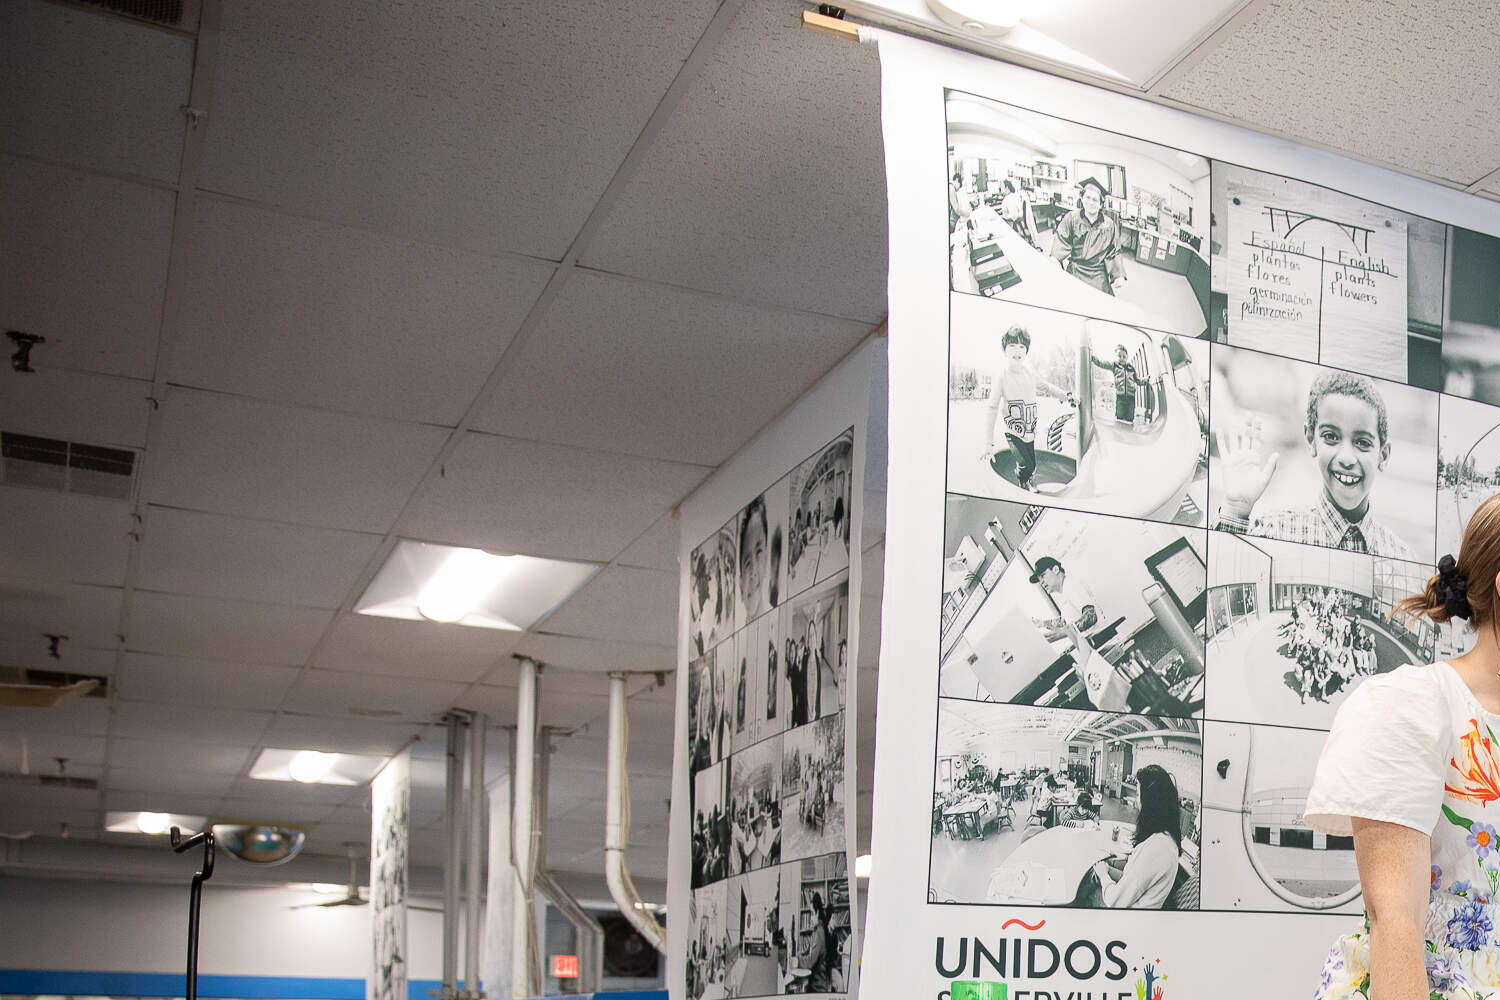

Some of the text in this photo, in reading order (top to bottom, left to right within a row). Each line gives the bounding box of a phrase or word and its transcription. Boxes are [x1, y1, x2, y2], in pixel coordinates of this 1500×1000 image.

[1251, 231, 1306, 255] Español
[1253, 252, 1301, 271] plantas
[1338, 250, 1389, 274] English
[1247, 266, 1291, 286] flores
[1335, 265, 1376, 288] plants
[1330, 281, 1378, 304] flowers
[935, 937, 1128, 981] UNIDOS
